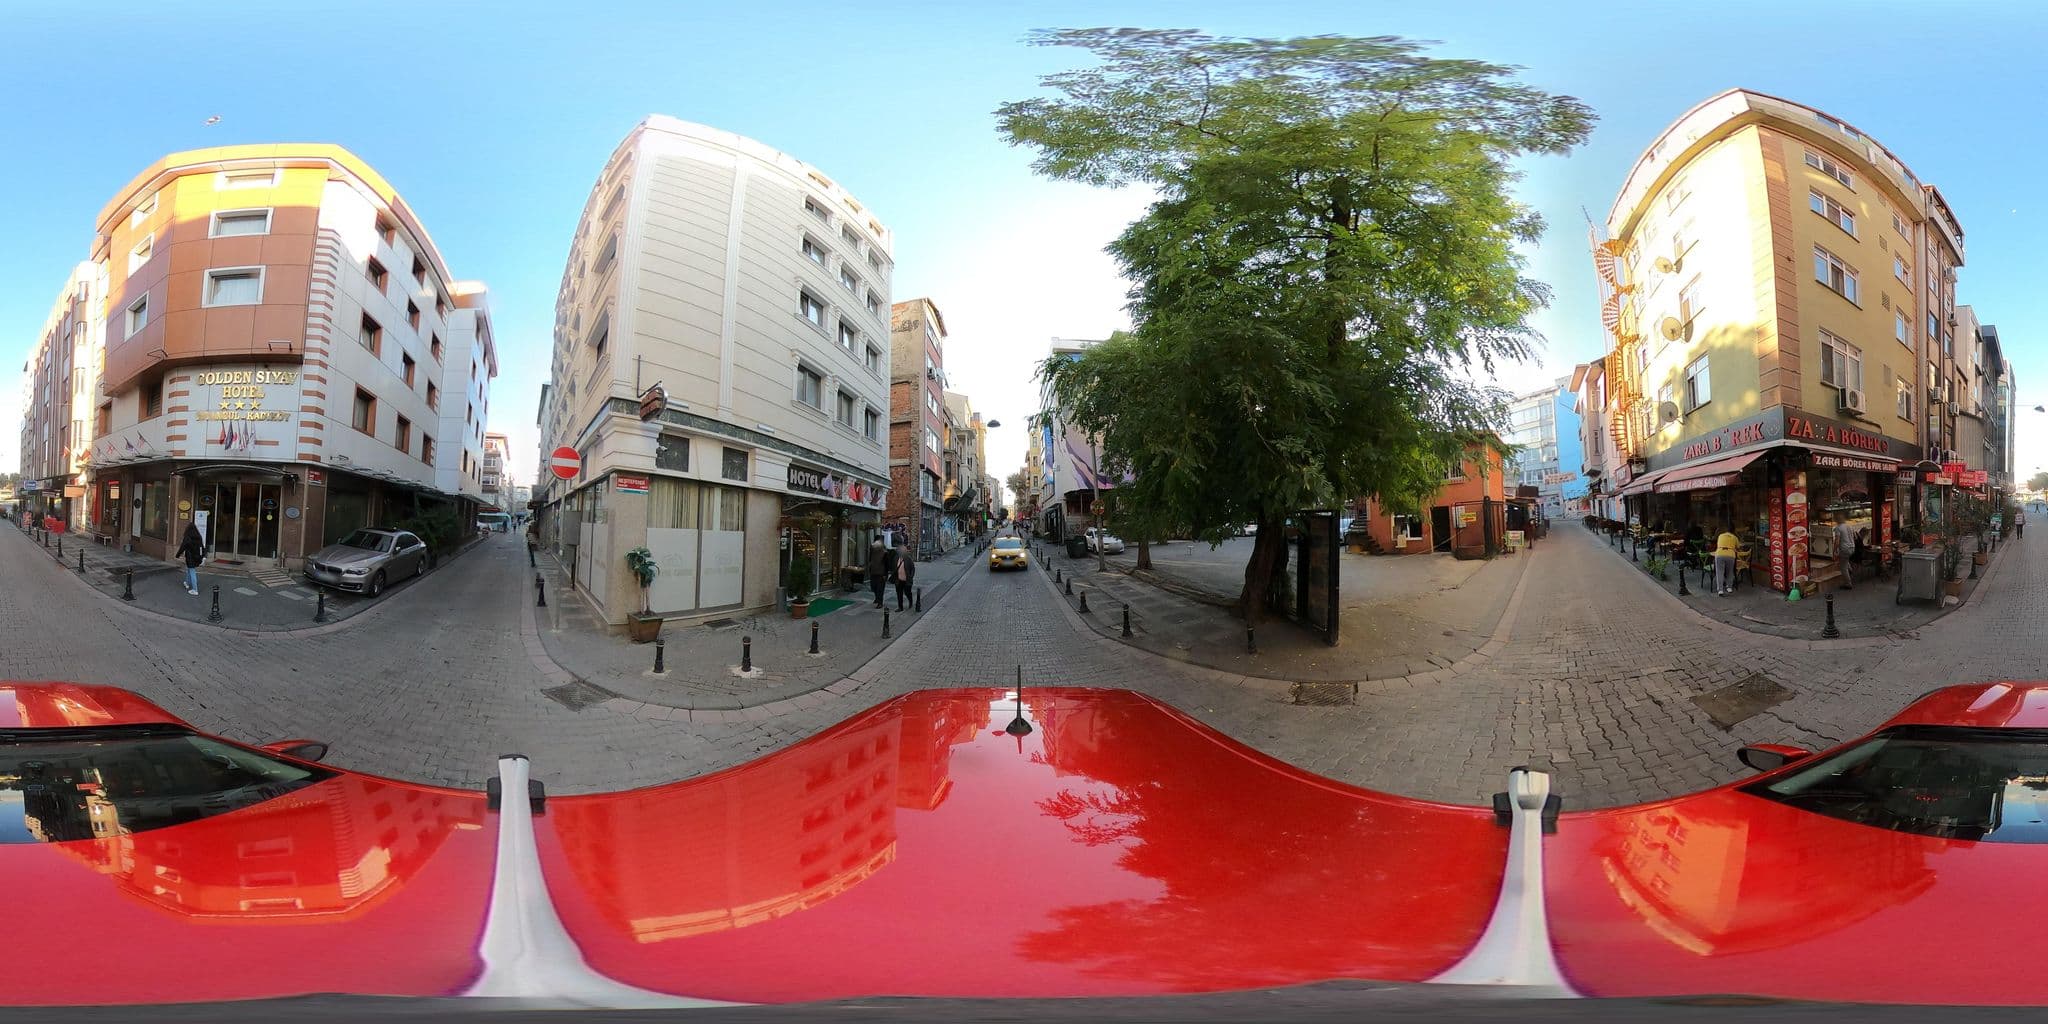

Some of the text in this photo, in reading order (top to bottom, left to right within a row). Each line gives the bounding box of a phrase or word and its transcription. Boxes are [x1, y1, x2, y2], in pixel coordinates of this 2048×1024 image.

[198, 371, 252, 385] GOLDEN
[222, 385, 265, 399] HOTEL
[1841, 426, 1880, 452] BÖREK
[1682, 440, 1710, 460] ZARA
[1815, 455, 1841, 467] ZARA
[790, 469, 819, 489] HOTEL
